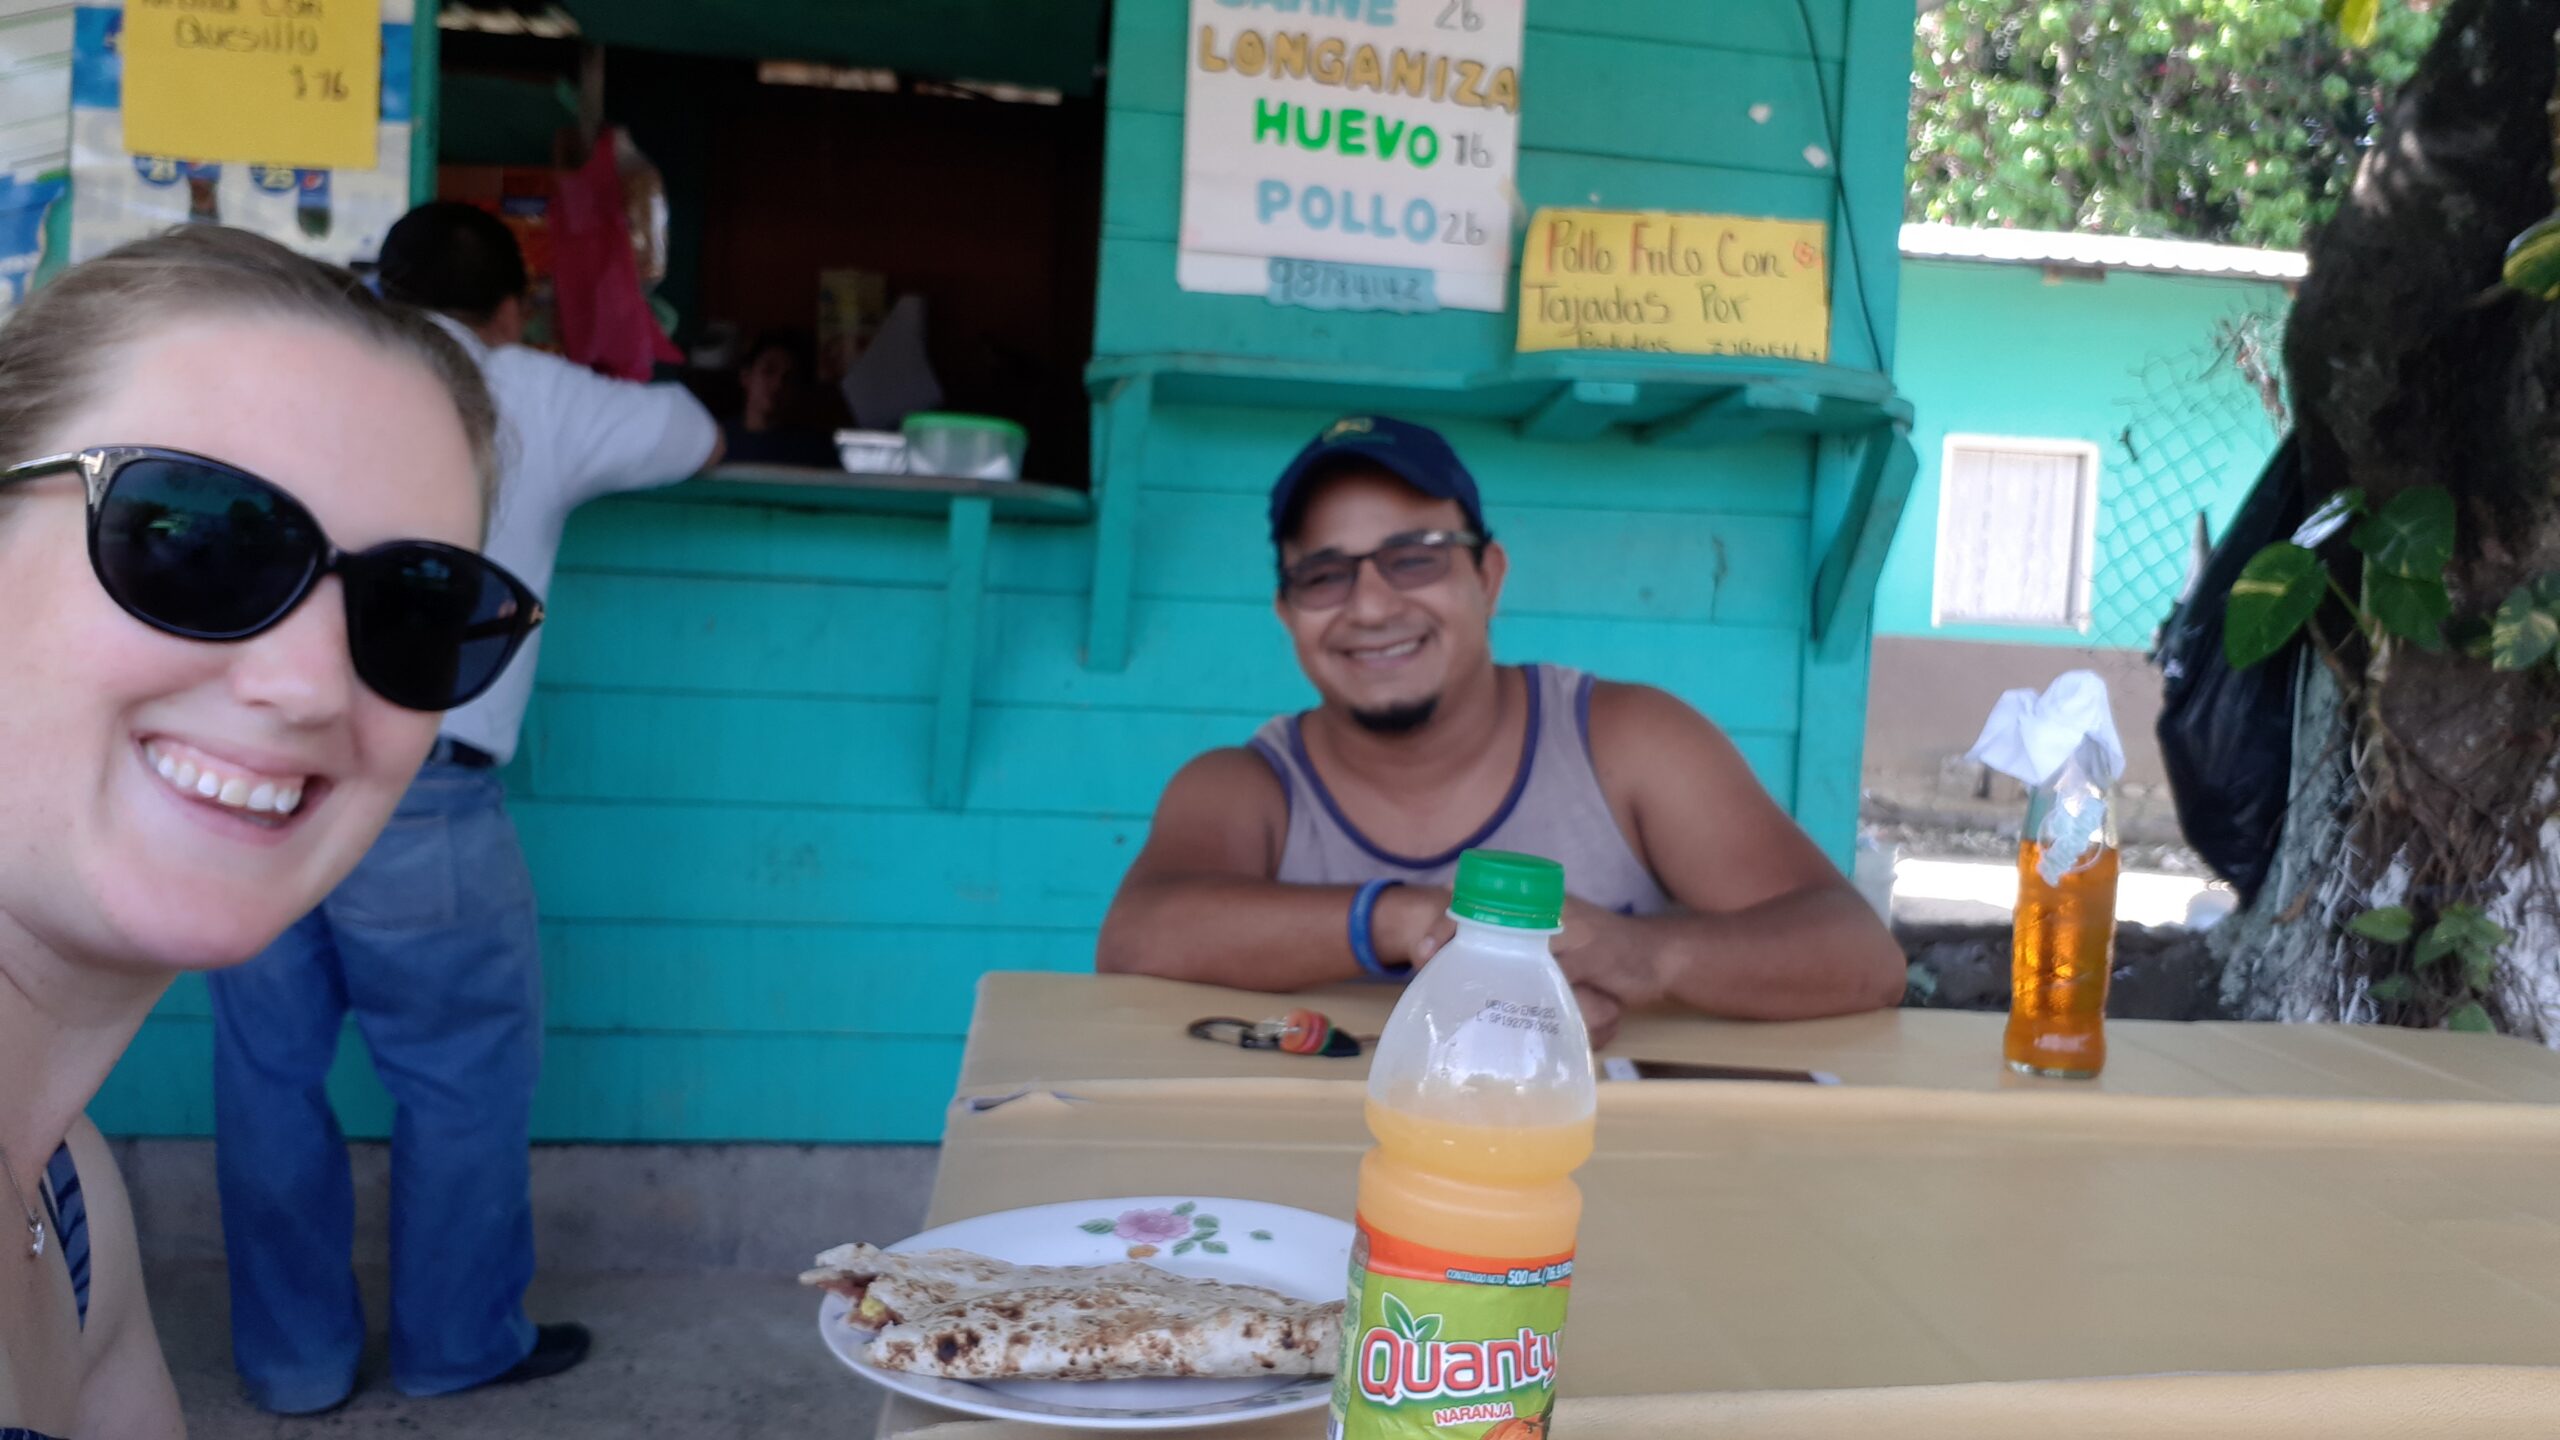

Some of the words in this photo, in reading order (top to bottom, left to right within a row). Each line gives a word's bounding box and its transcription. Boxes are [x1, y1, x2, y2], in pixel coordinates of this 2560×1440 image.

[1199, 25, 1520, 113] LONGANIZA
[1254, 97, 1439, 167] HUEVO
[1256, 179, 1438, 244] POLLO
[1547, 219, 1612, 275] Pollo
[1716, 229, 1787, 278] Con
[1525, 282, 1672, 338] Tajadas
[1699, 282, 1749, 325] Por
[1507, 1269, 1529, 1286] 500
[1359, 1327, 1561, 1405] Quanty
[1435, 1404, 1513, 1426] NARANJA
